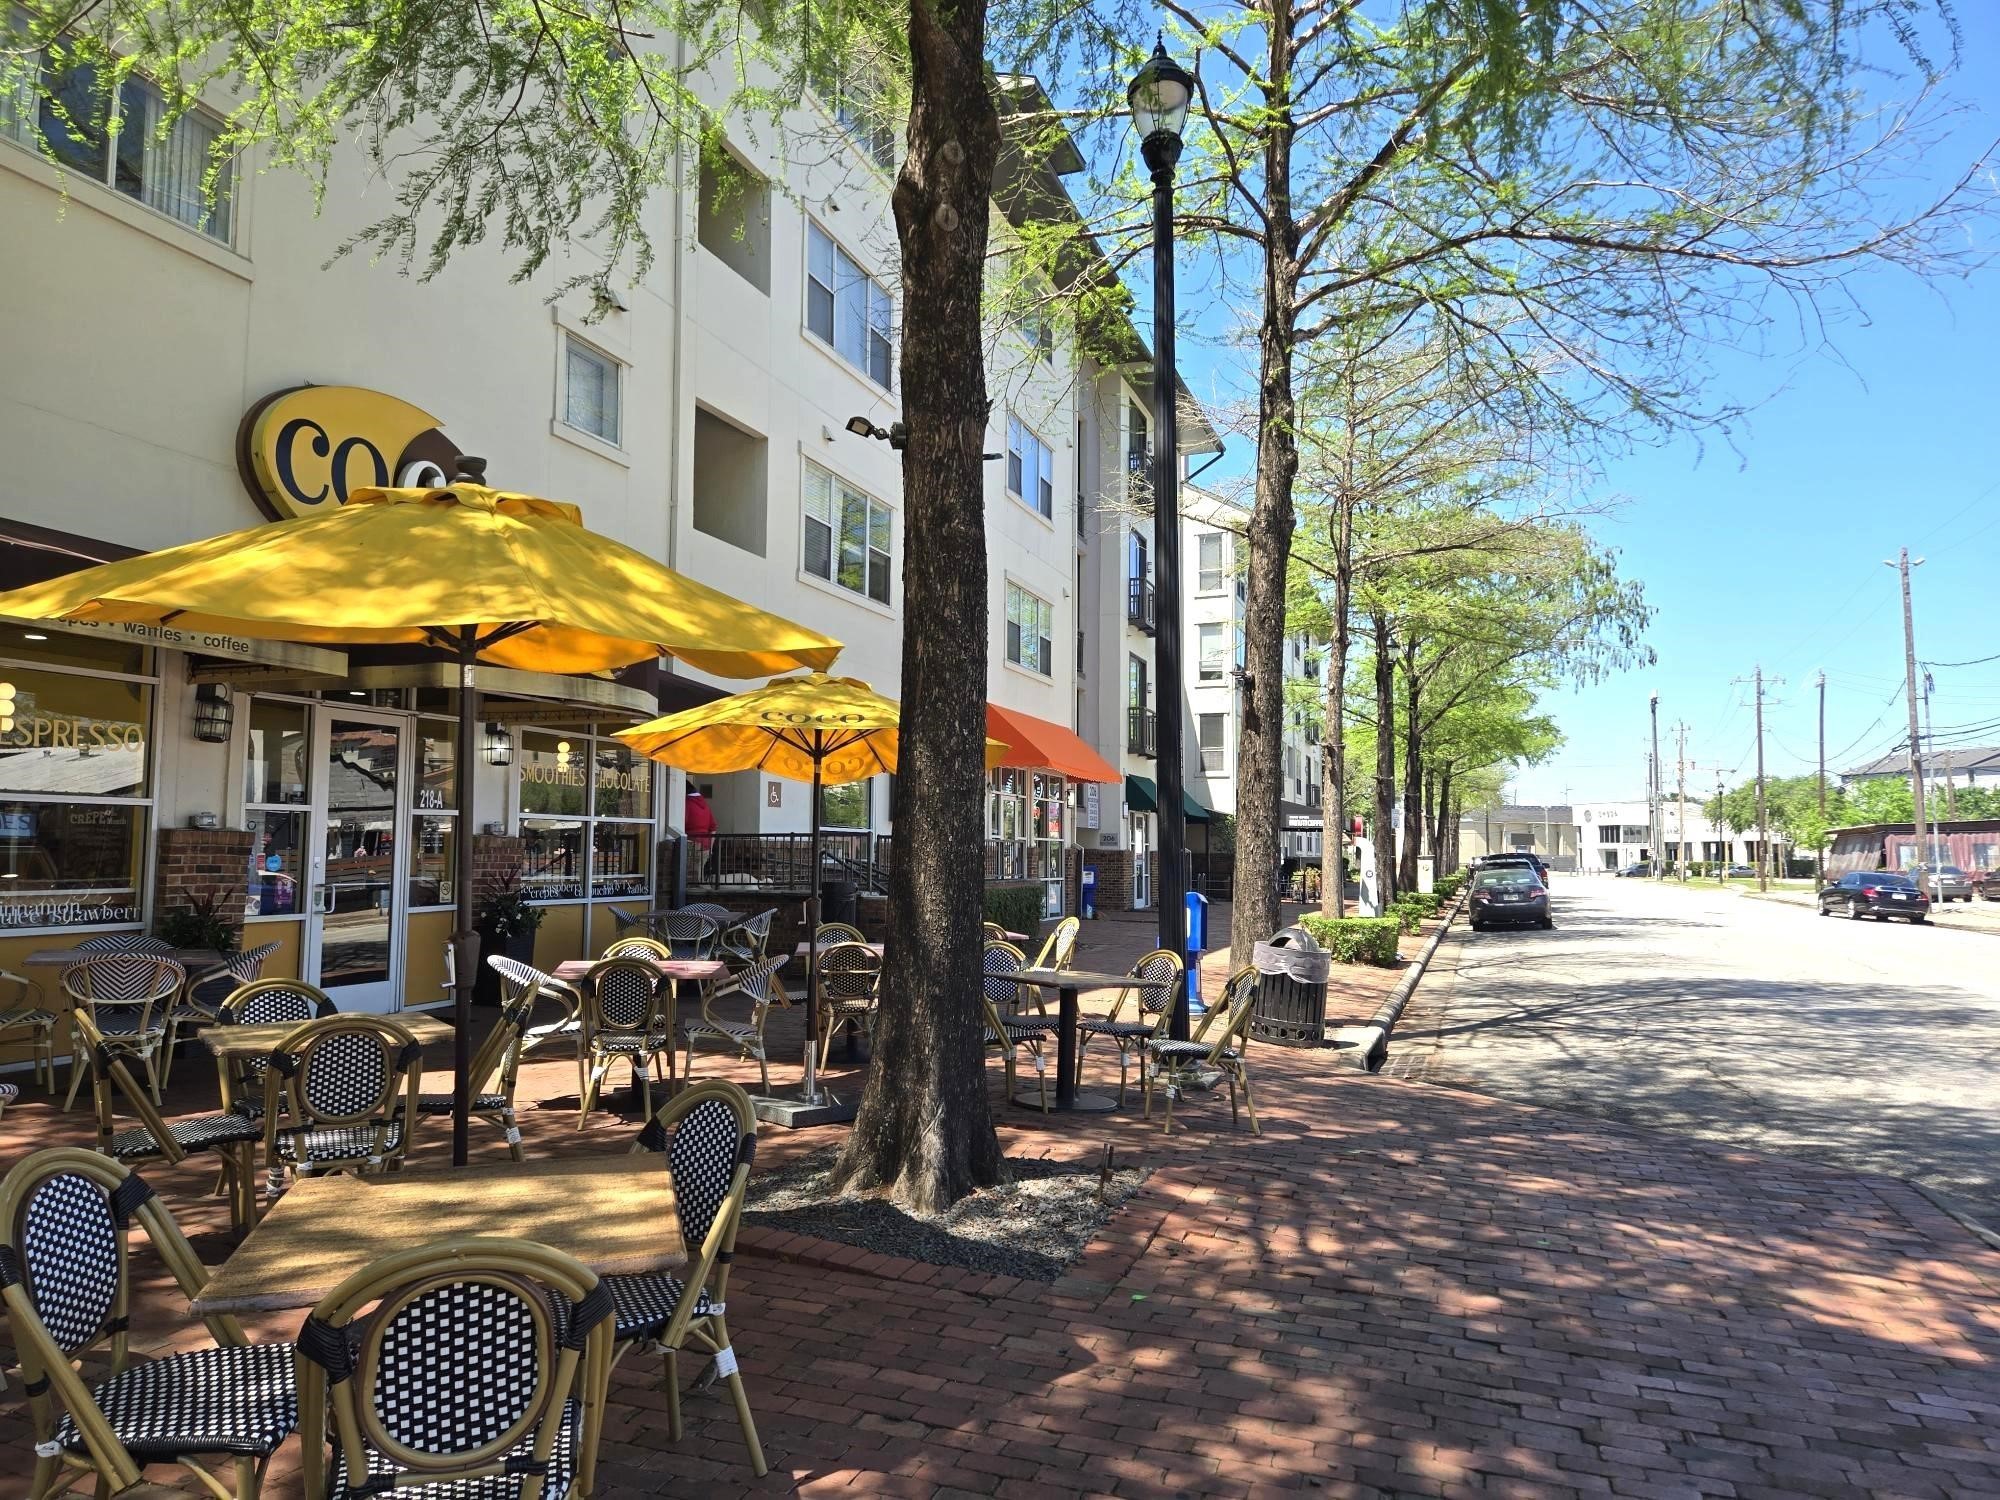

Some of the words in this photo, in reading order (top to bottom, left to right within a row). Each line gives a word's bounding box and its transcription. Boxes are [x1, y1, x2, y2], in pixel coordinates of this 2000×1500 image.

[124, 622, 182, 642] waffles
[203, 634, 249, 653] coffee
[520, 762, 586, 787] SMOOTHIES
[595, 772, 651, 793] CHOCOLATE
[420, 789, 443, 809] 218-A
[0, 902, 81, 917] innamon
[52, 902, 139, 923] strawberr
